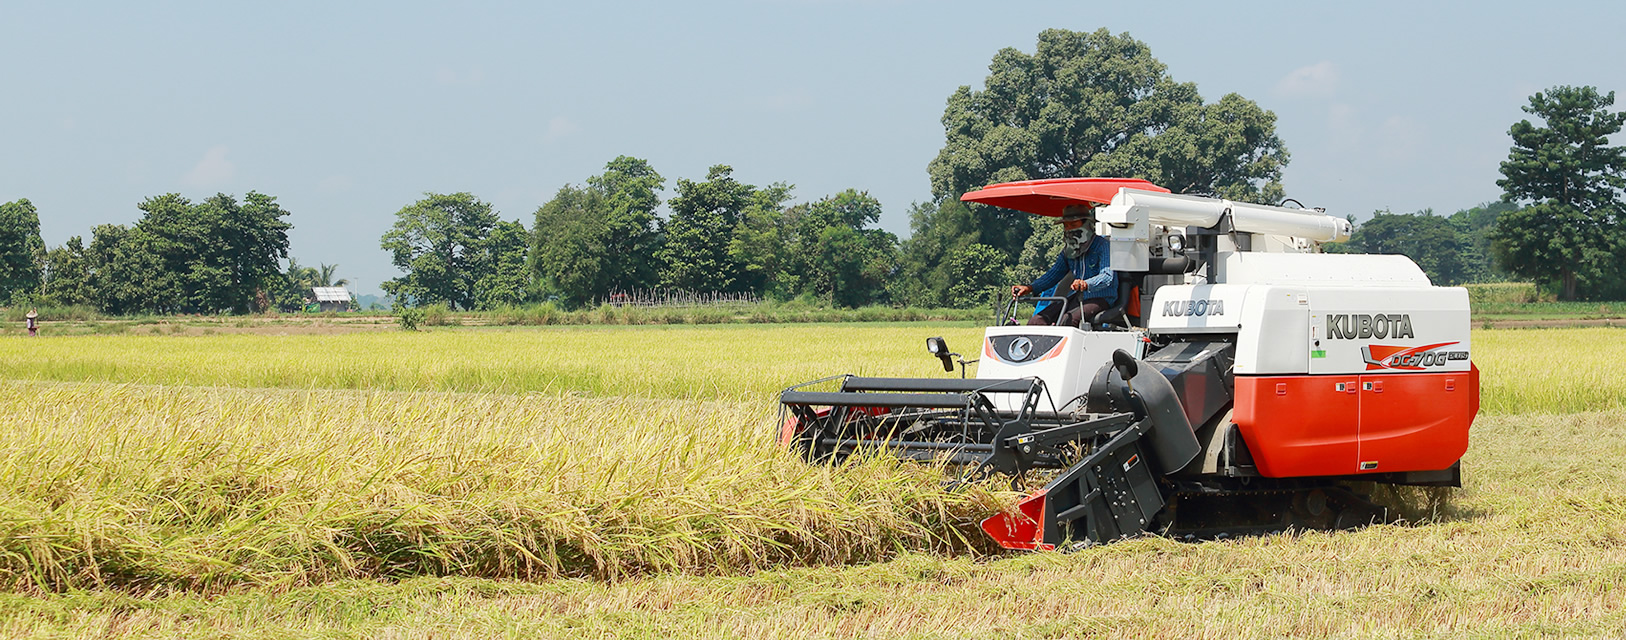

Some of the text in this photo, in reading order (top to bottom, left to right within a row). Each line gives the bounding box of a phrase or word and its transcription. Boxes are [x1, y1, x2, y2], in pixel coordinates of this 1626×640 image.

[1162, 300, 1224, 316] KUBOTA
[1327, 314, 1414, 339] KUBOTA
[1391, 352, 1447, 366] DC-70G
